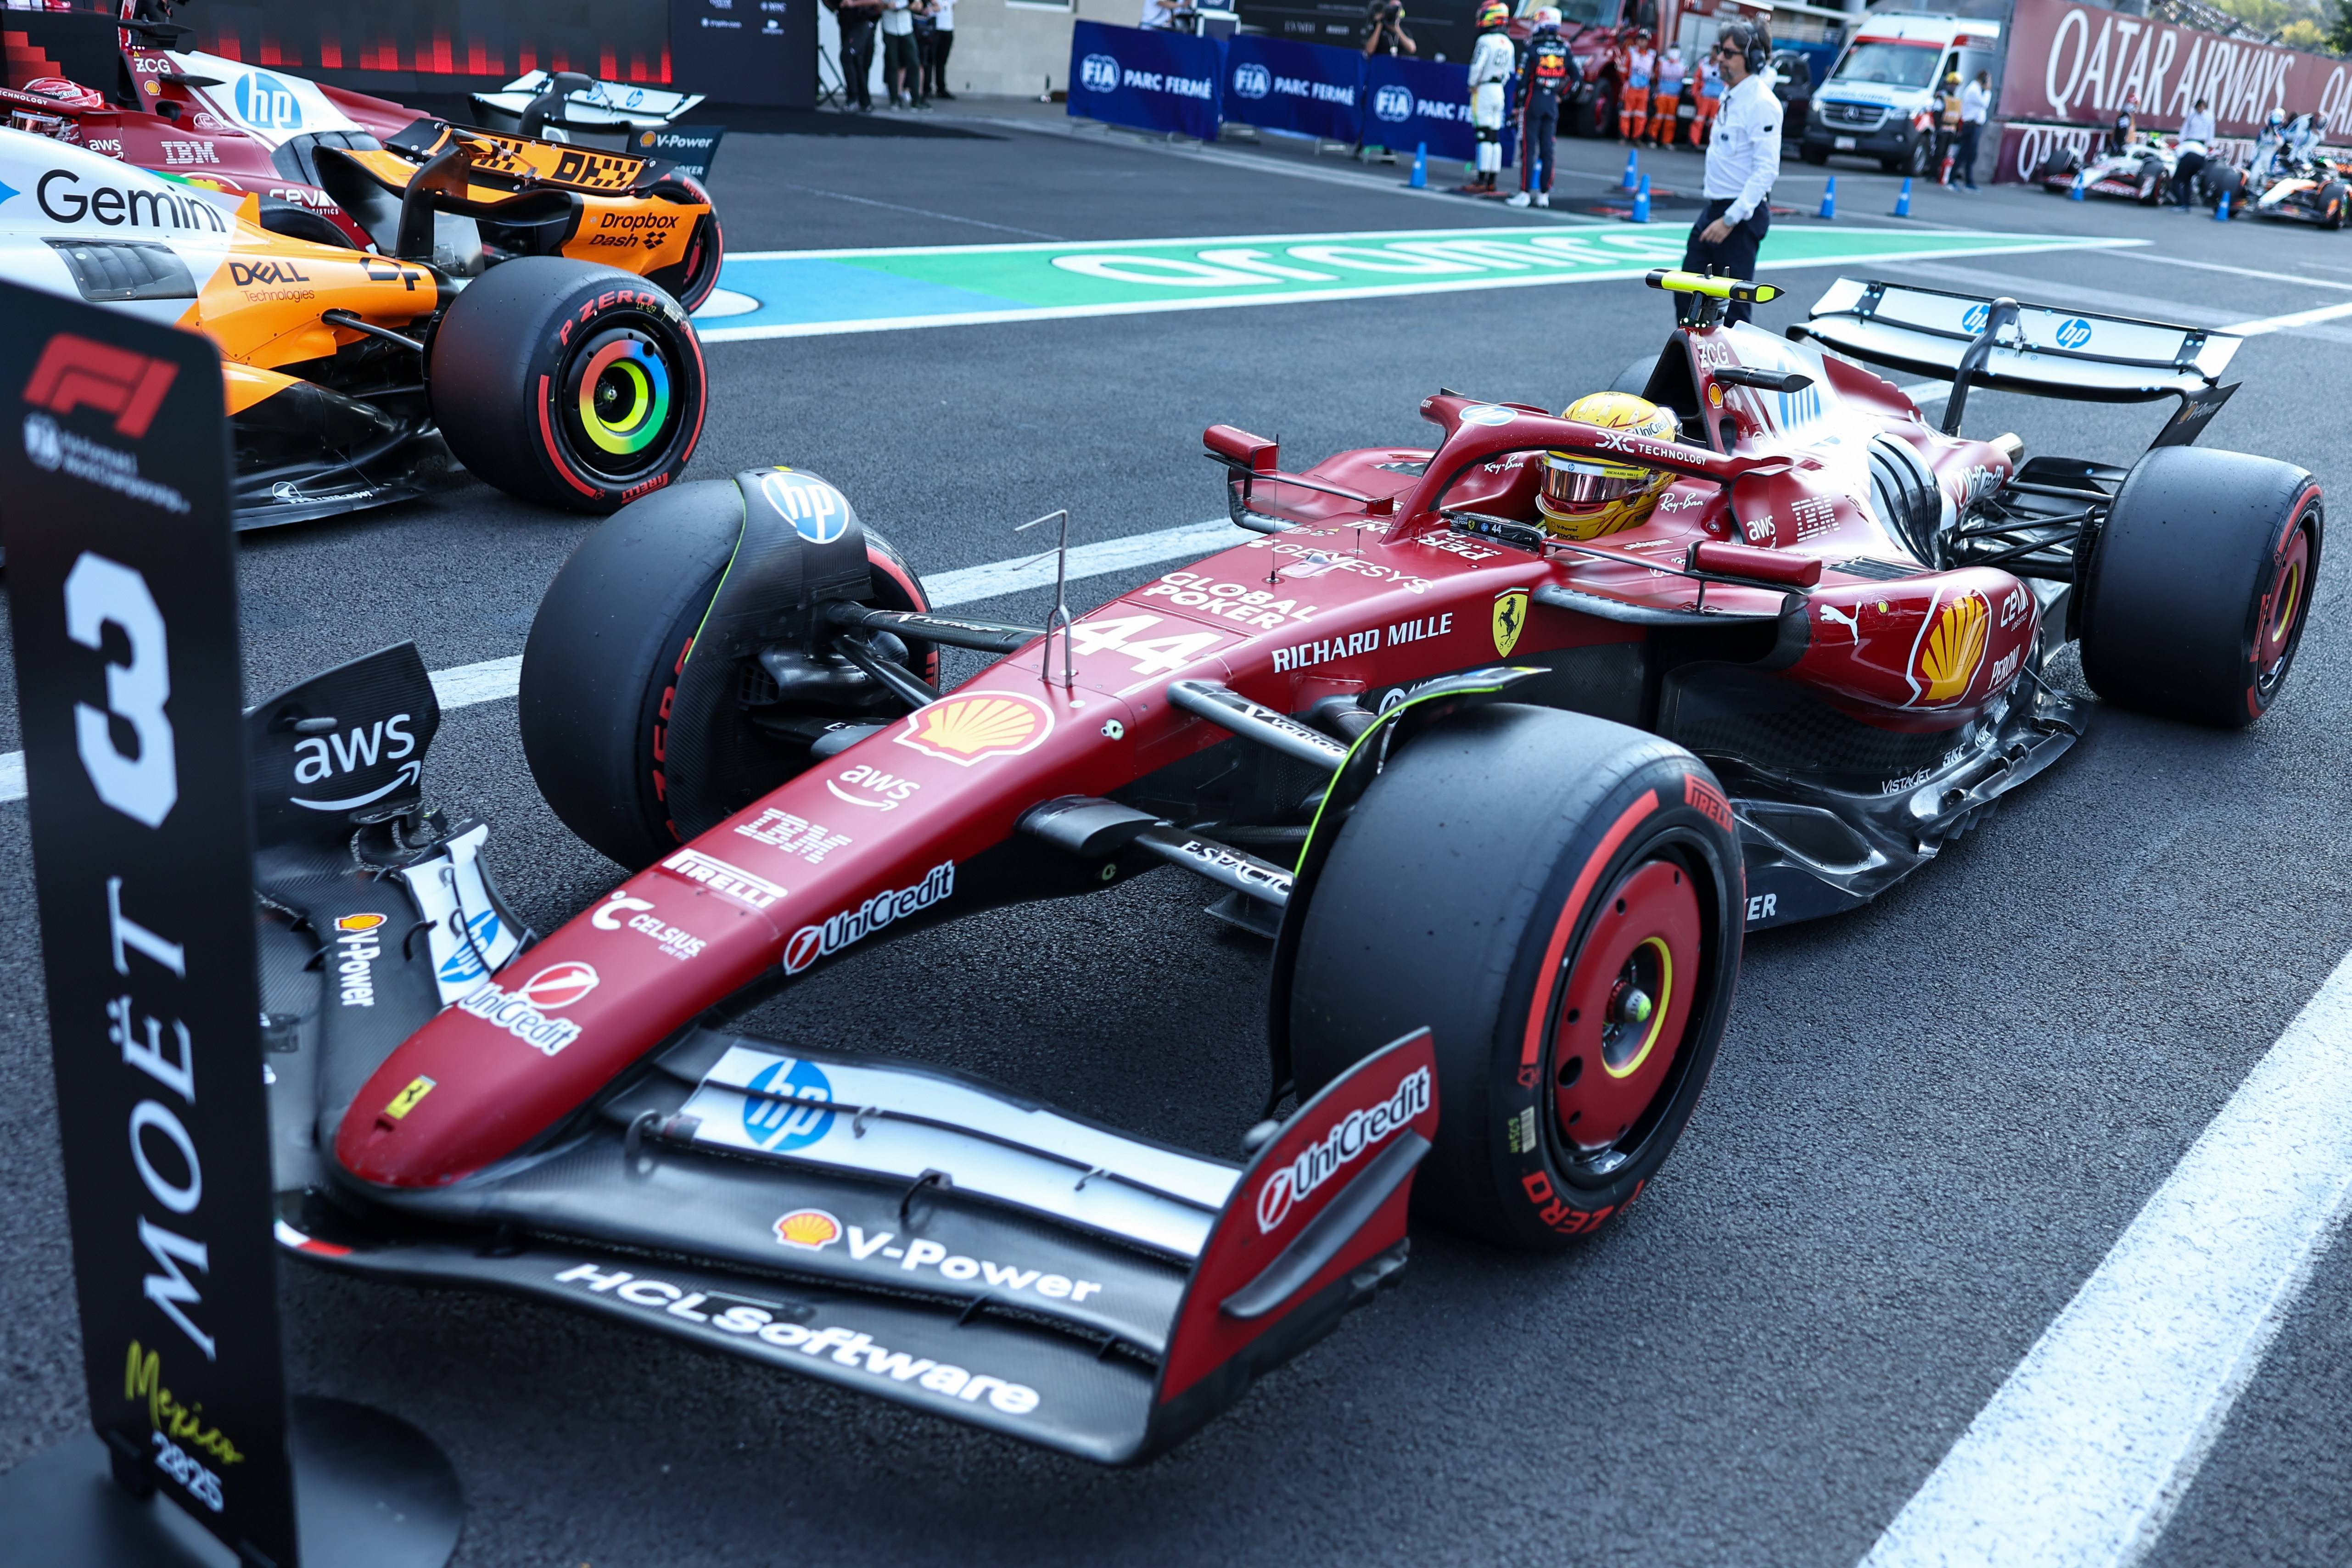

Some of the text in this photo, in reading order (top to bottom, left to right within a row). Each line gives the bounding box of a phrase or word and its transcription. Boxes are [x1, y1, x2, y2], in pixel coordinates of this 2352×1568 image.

[1085, 61, 1212, 100] FIA PARC FERMÉ
[1237, 69, 1355, 106] FIA PARC FERMÉ
[2046, 8, 2178, 120] QATAR
[2166, 36, 2296, 124] AIRWAYS
[0, 90, 47, 106] ECHNOLOGY
[248, 73, 292, 128] hp
[1376, 93, 1409, 116] FIA
[1417, 99, 1455, 121] PARC
[90, 139, 121, 151] aws
[161, 141, 220, 164] IBM
[657, 135, 712, 147] V-Power
[674, 165, 703, 176] OKER
[37, 169, 226, 233] Gemini
[600, 213, 680, 230] Dropbox
[590, 233, 638, 247] Dash
[230, 261, 309, 286] DELL
[241, 288, 314, 302] Technologies
[560, 290, 656, 346] P ZERO
[2061, 319, 2088, 348] hp
[1484, 455, 1524, 473] Ray-Ban
[1595, 431, 1707, 466] DXC TECHNOLOGY
[621, 472, 669, 504] PIRELLI
[780, 474, 835, 544] hp
[1659, 492, 1704, 512] Ray-Ban
[1492, 524, 1502, 534] 44
[1557, 524, 1579, 532] V-Power
[1746, 515, 1776, 541] aws
[1792, 494, 1841, 542] IBM
[1142, 583, 1285, 630] POKER
[1159, 572, 1320, 623] GLOBAL
[1058, 614, 1224, 675] 44
[1271, 612, 1453, 673] RICHARD MILLE
[63, 550, 178, 829] 3
[1988, 644, 2020, 690] PERONI
[294, 714, 415, 784] aws
[1943, 744, 1966, 767] SKF
[839, 765, 920, 800] aws
[1684, 773, 1733, 833] PIRELLI
[1882, 768, 1931, 794] VISTAJET
[734, 808, 853, 864] IBM
[661, 849, 789, 908] PIRELLI
[825, 863, 952, 950] UniCredit
[339, 928, 381, 1006] V-Power
[461, 984, 580, 1052] UniCredit
[107, 876, 216, 1361] MOËT
[747, 1059, 832, 1151] hp
[1295, 1070, 1428, 1196] UniCredit
[846, 1226, 1103, 1302] V-Power
[151, 1430, 224, 1512] 2025
